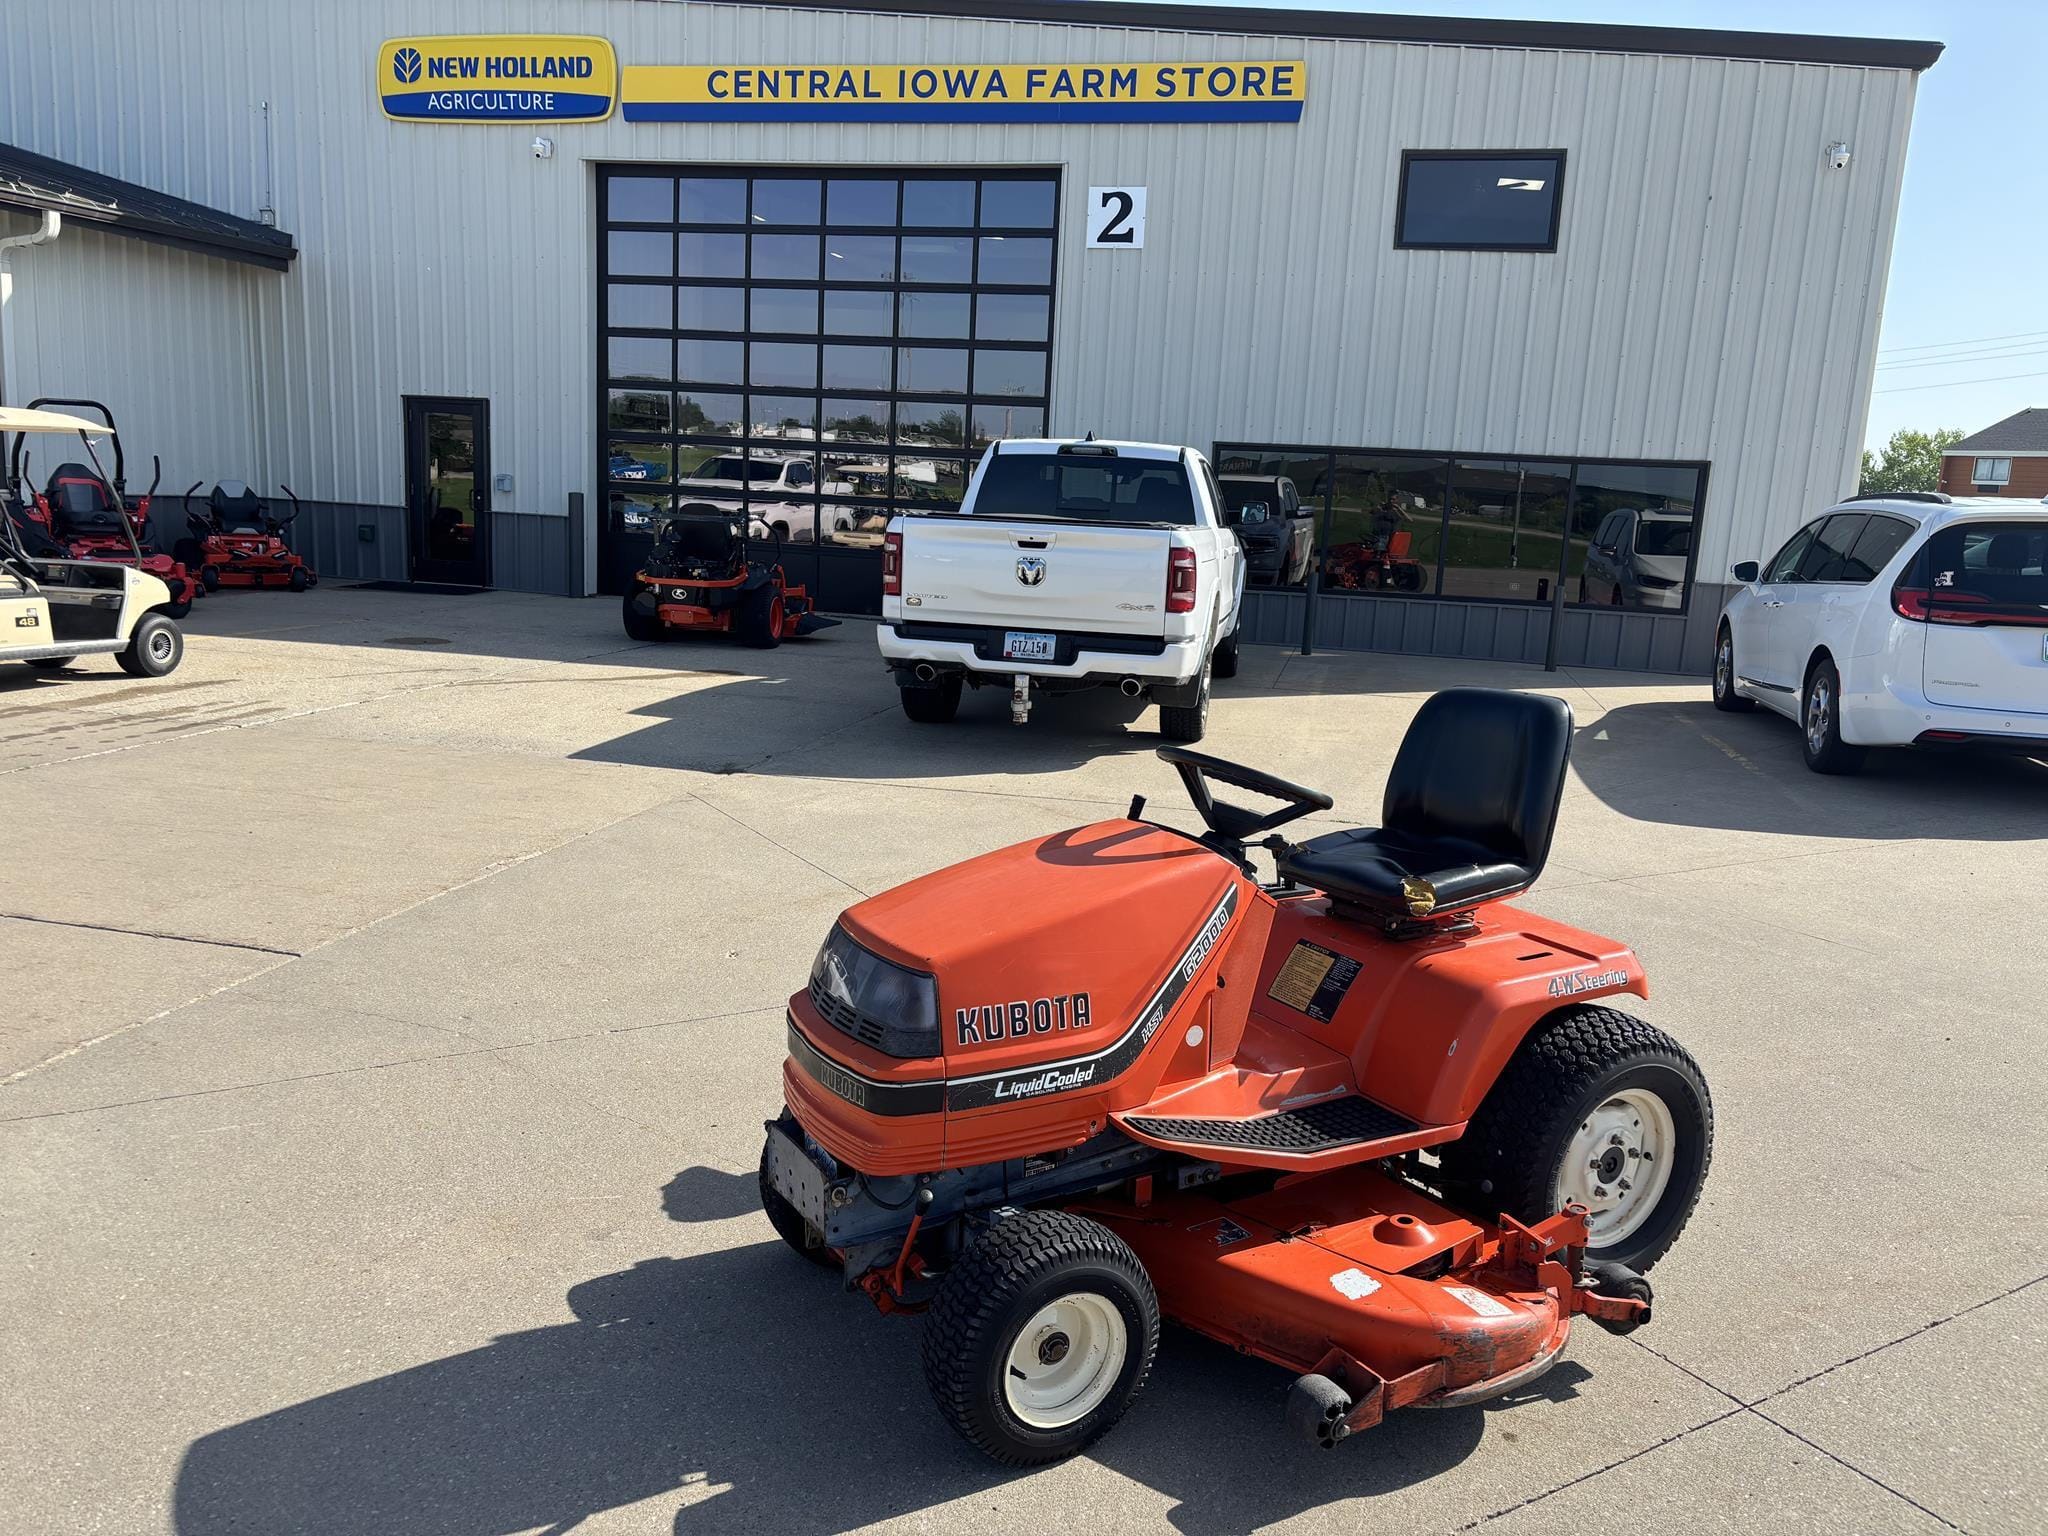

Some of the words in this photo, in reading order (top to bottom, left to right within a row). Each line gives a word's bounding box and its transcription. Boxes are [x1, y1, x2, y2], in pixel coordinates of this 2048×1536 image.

[428, 57, 479, 78] NEW
[485, 56, 593, 78] HOLLAND
[707, 69, 882, 98] CENTRAL
[898, 69, 1008, 98] IOWA
[1026, 68, 1138, 98] FARM
[1155, 66, 1294, 97] STORE
[428, 93, 554, 110] AGRICULTURE
[1097, 191, 1134, 243] 2
[18, 618, 36, 626] 48
[1012, 640, 1028, 653] GTZ
[1183, 907, 1229, 981] G2000
[956, 991, 1092, 1046] KUBOTA
[1141, 1003, 1164, 1044] HST
[820, 1063, 865, 1107] KUBOTA
